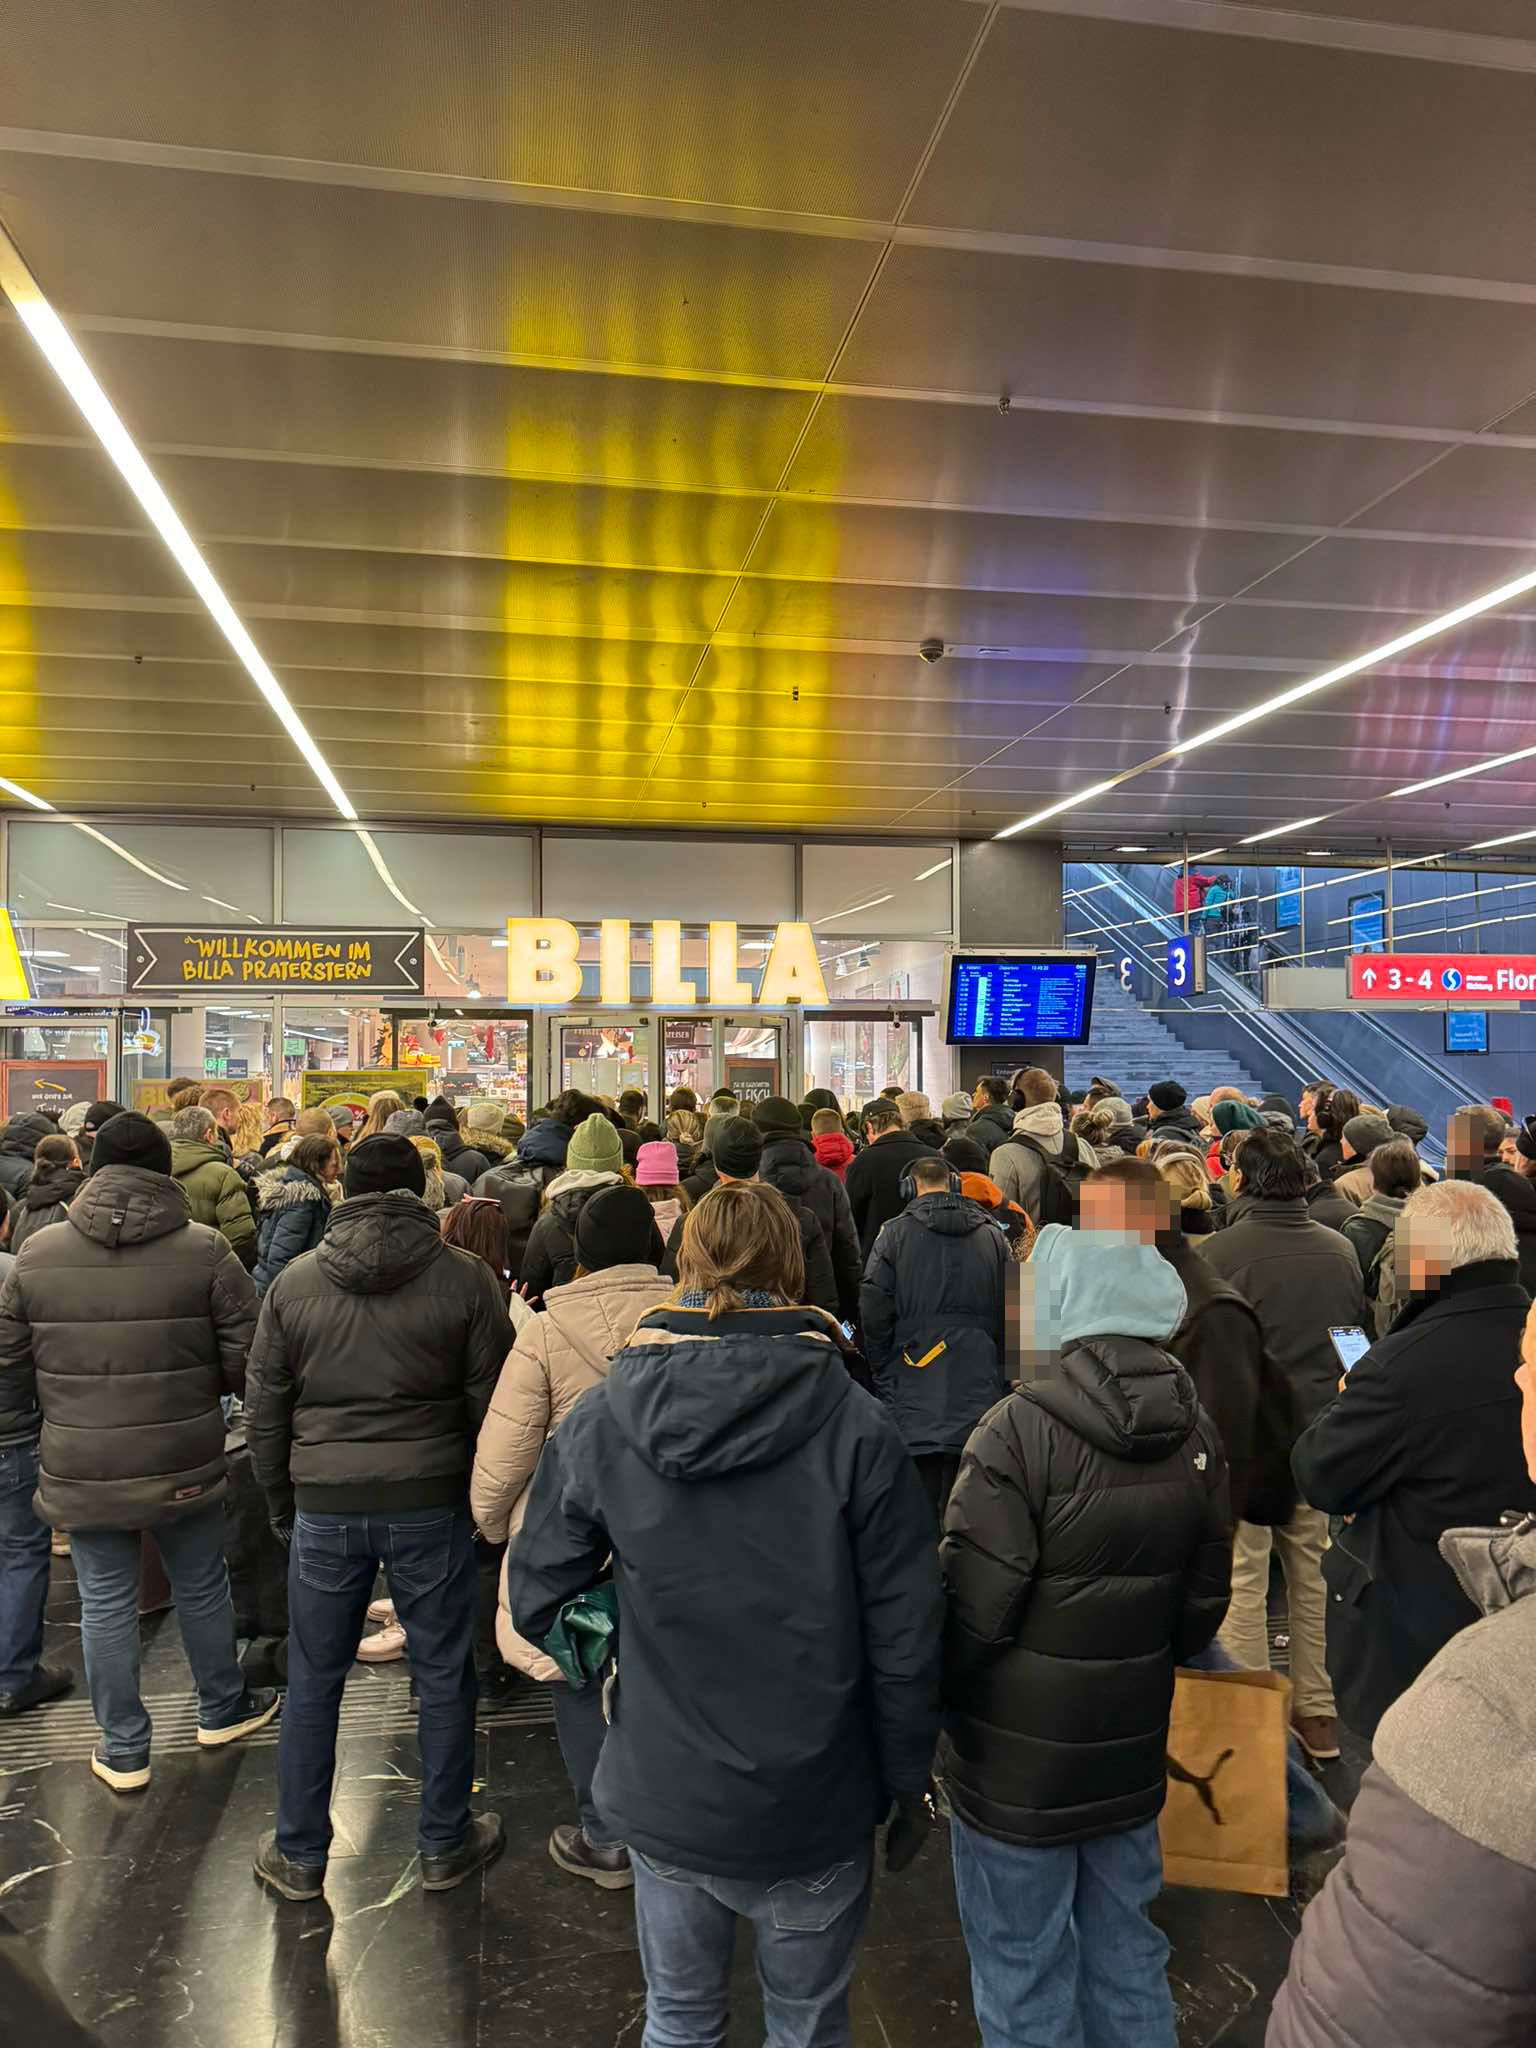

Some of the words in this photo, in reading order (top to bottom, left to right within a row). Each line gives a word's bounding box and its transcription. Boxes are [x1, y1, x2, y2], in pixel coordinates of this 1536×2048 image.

[186, 936, 340, 960] WILLKOMMEN
[348, 941, 371, 961] IM
[507, 917, 830, 1005] BILLA
[182, 960, 234, 981] BILLA
[242, 961, 372, 981] PRATERSTERN
[1174, 947, 1186, 986] 3
